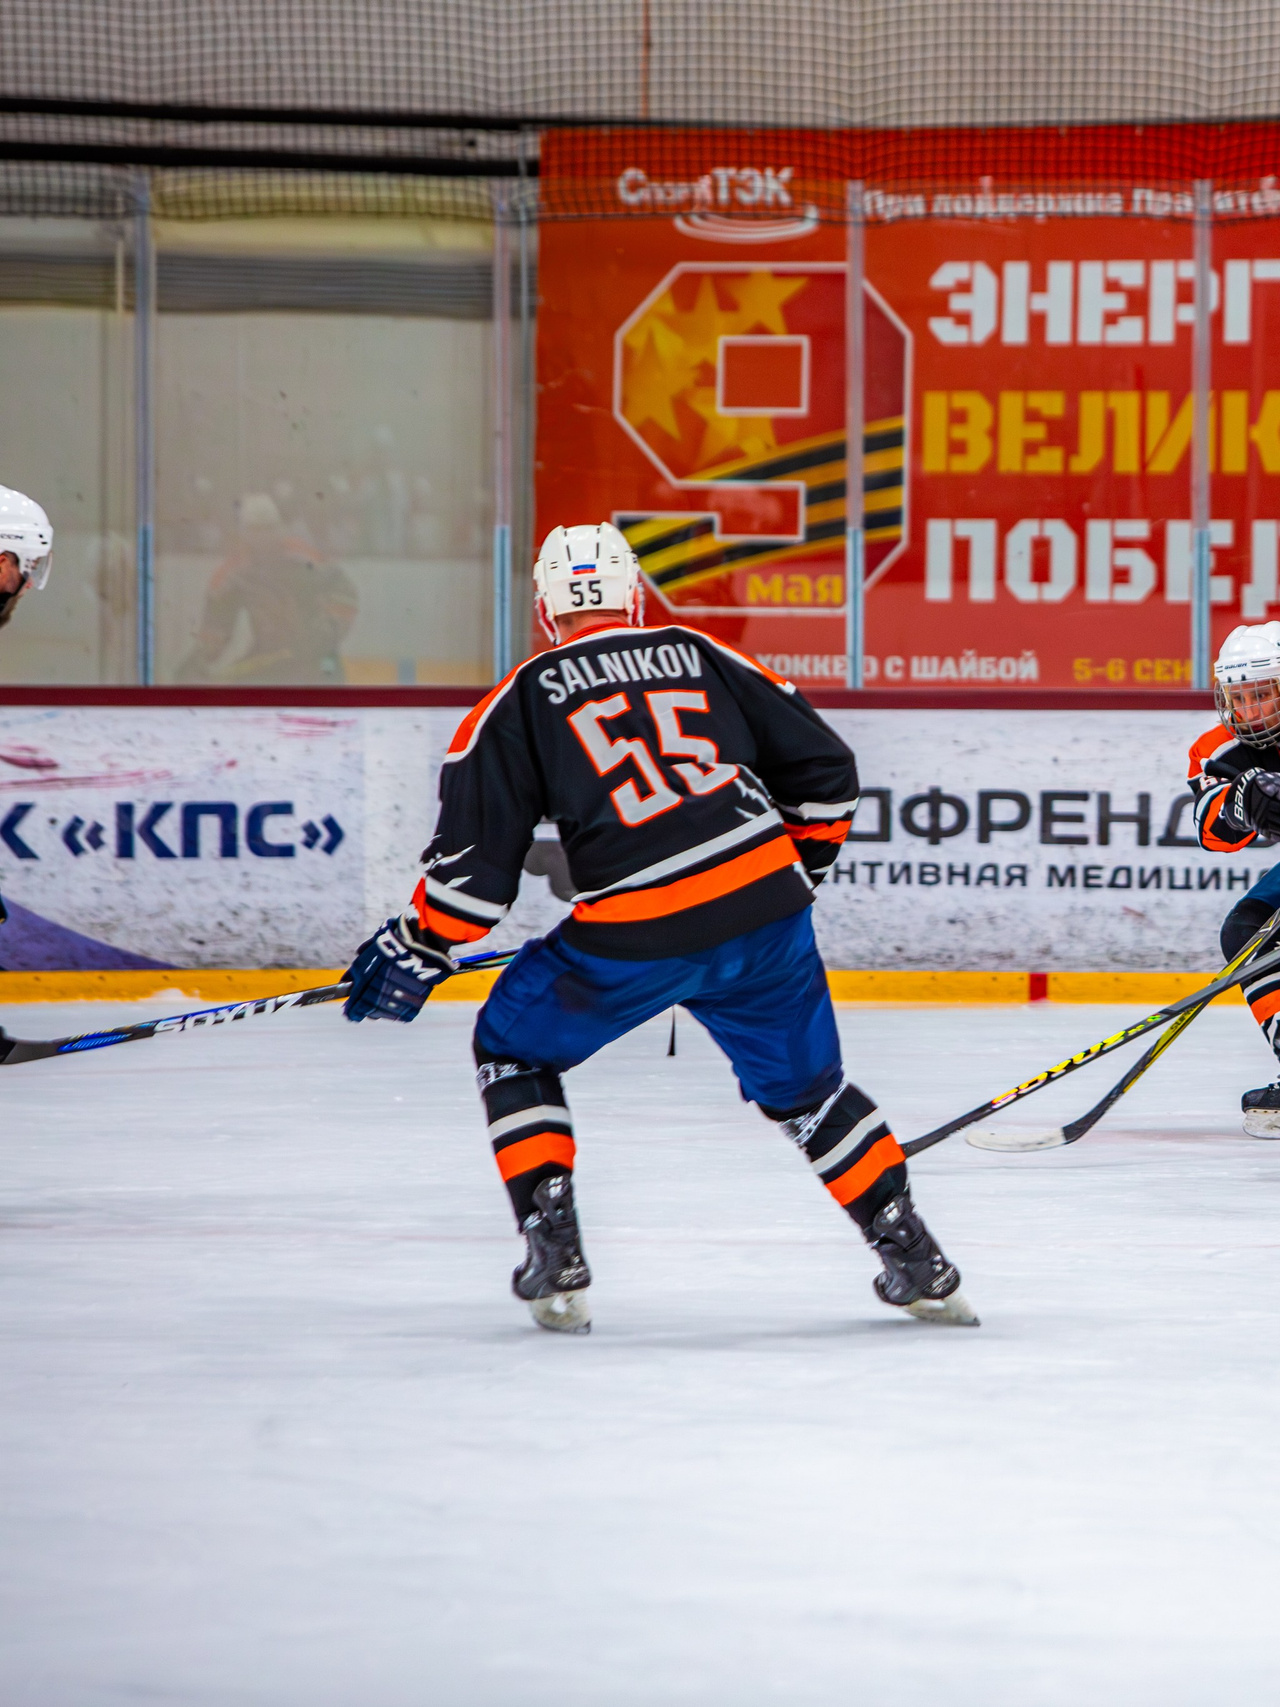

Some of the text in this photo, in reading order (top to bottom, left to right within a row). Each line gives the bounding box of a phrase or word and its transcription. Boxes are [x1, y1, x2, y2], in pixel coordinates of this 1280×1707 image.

[568, 580, 602, 606] 55
[745, 570, 843, 603] мая
[538, 643, 702, 705] SALNIKOV
[885, 656, 904, 679] С
[911, 648, 1039, 680] ШАЙБОЙ
[1073, 657, 1125, 682] 5-6
[566, 688, 740, 828] 55
[61, 801, 345, 860] «КПС»
[824, 861, 1270, 891] НТИВНАЯ МЕДИЦИН
